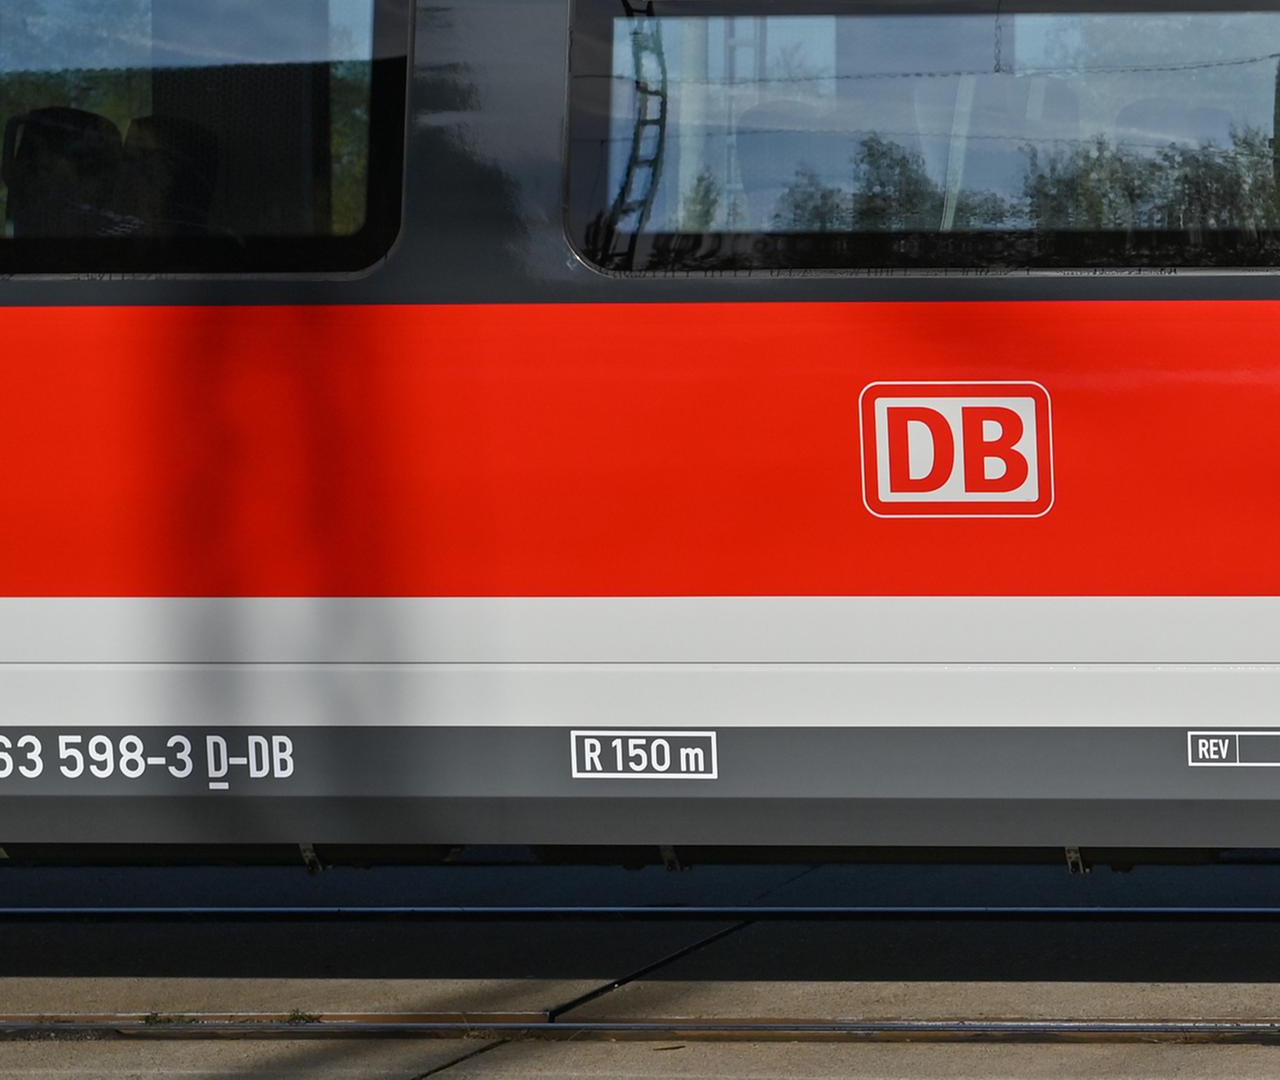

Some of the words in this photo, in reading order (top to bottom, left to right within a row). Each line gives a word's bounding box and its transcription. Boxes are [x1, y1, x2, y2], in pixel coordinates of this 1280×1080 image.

[886, 406, 1029, 493] DB
[58, 734, 194, 779] 598-3
[206, 735, 295, 790] D-DB
[584, 738, 603, 772] R
[611, 738, 671, 772] 150
[679, 746, 705, 772] m
[1198, 738, 1230, 760] REV
